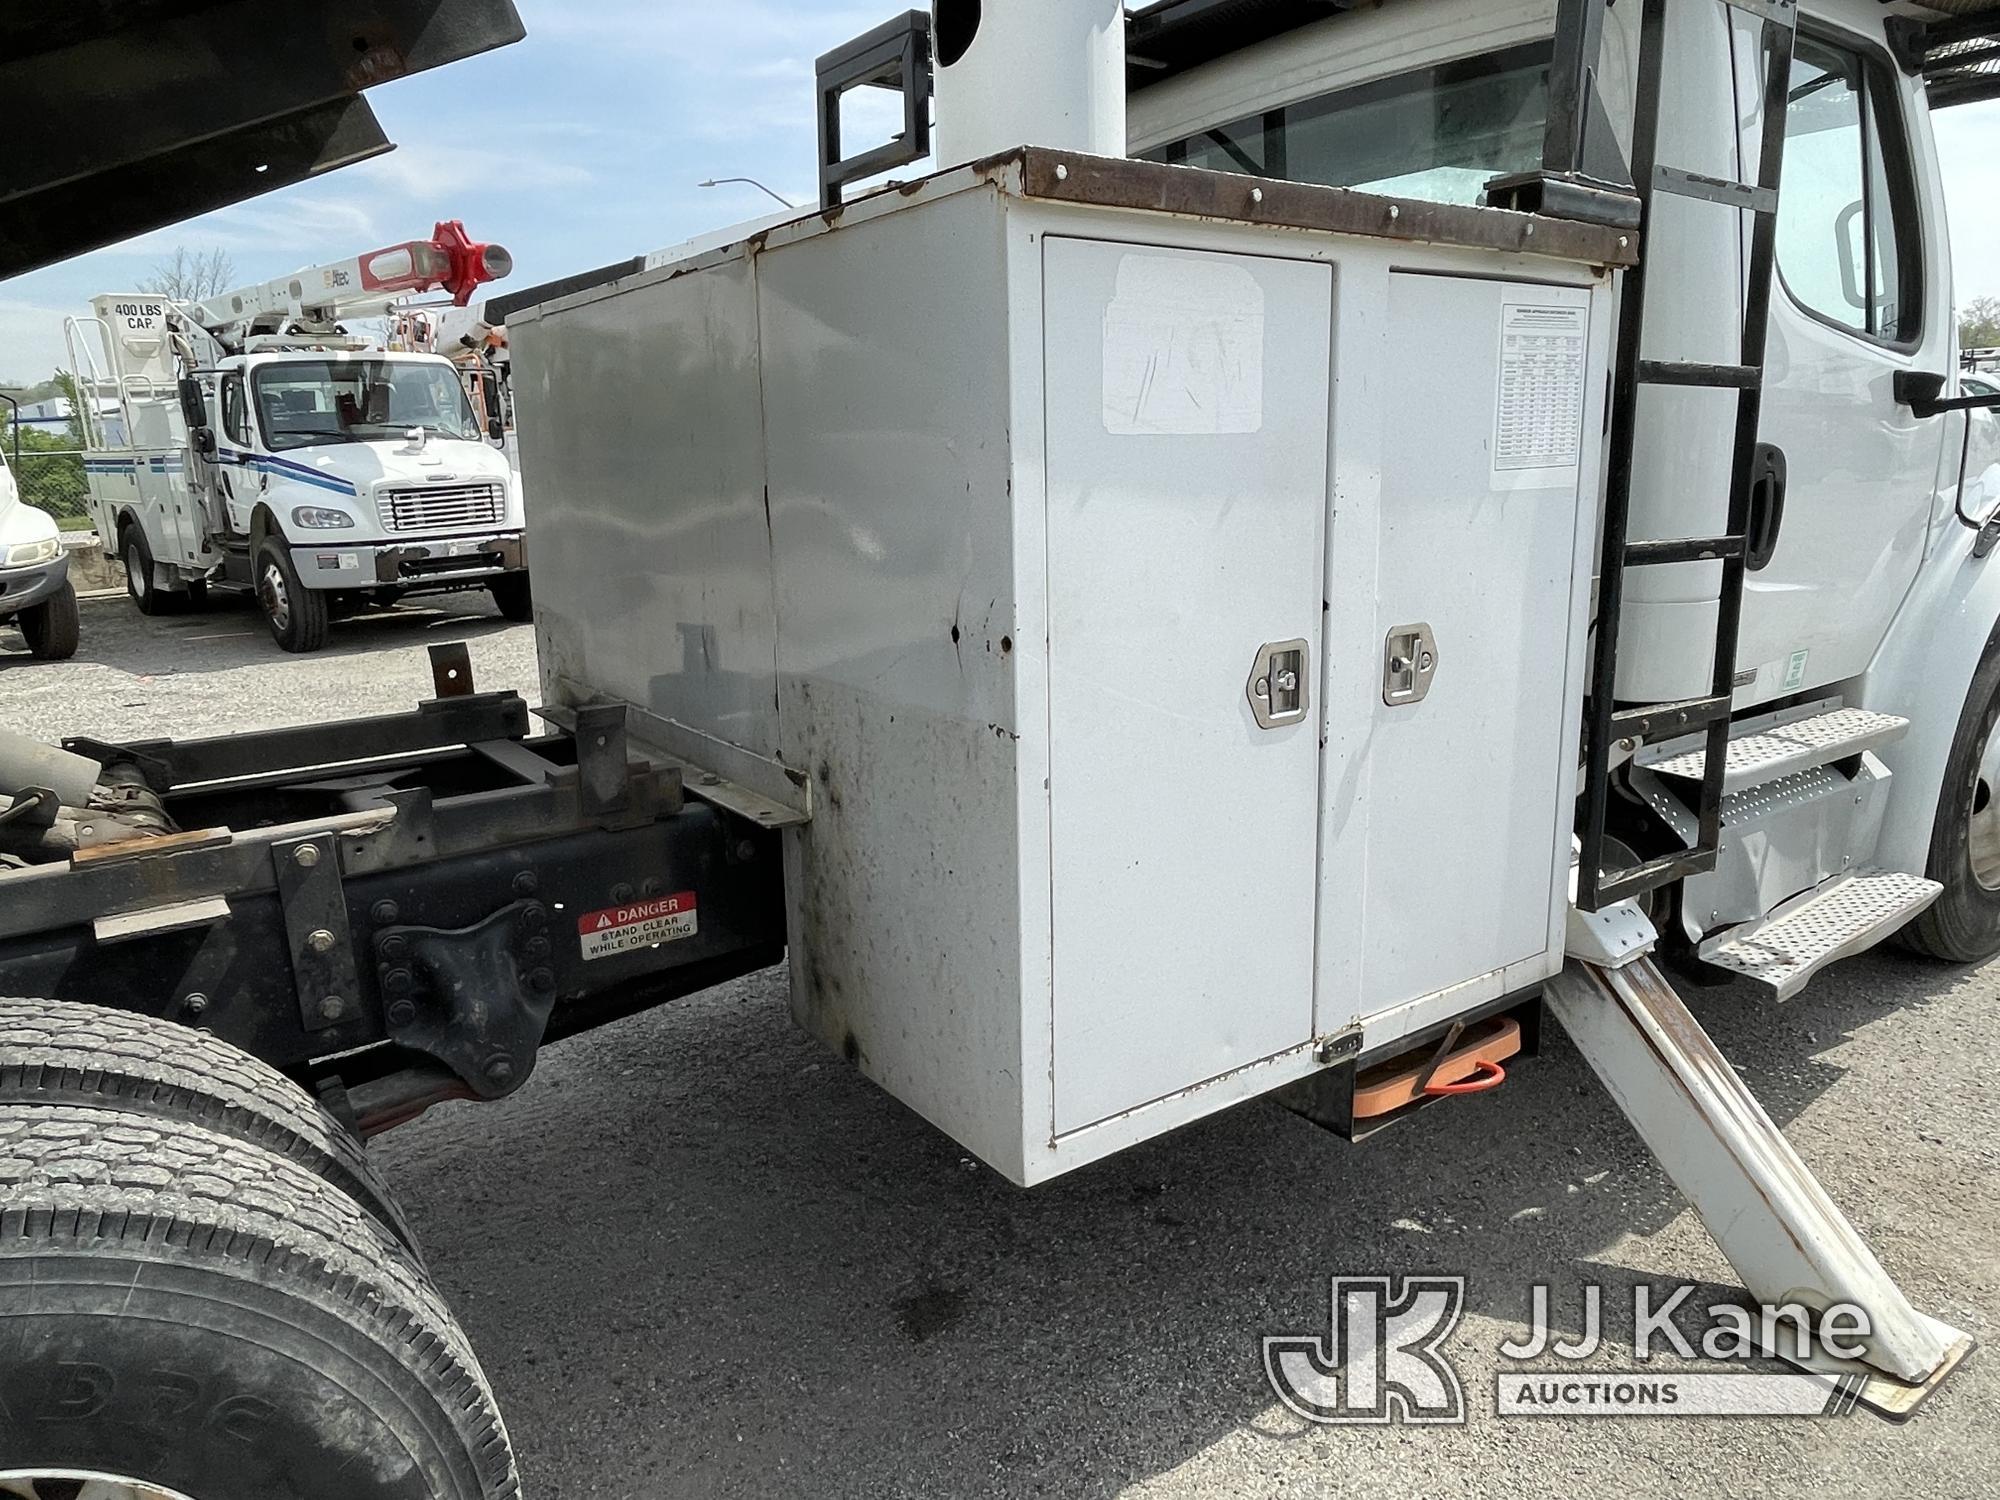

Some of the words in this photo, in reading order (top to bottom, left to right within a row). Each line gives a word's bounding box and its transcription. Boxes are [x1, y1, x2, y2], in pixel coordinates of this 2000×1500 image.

[115, 304, 138, 316] 400
[140, 304, 162, 316] LBS
[617, 899, 679, 922] DANGER
[589, 939, 625, 955] WHILE
[629, 923, 692, 945] OPERATING
[601, 926, 638, 942] STAND
[642, 916, 679, 932] CLEAR
